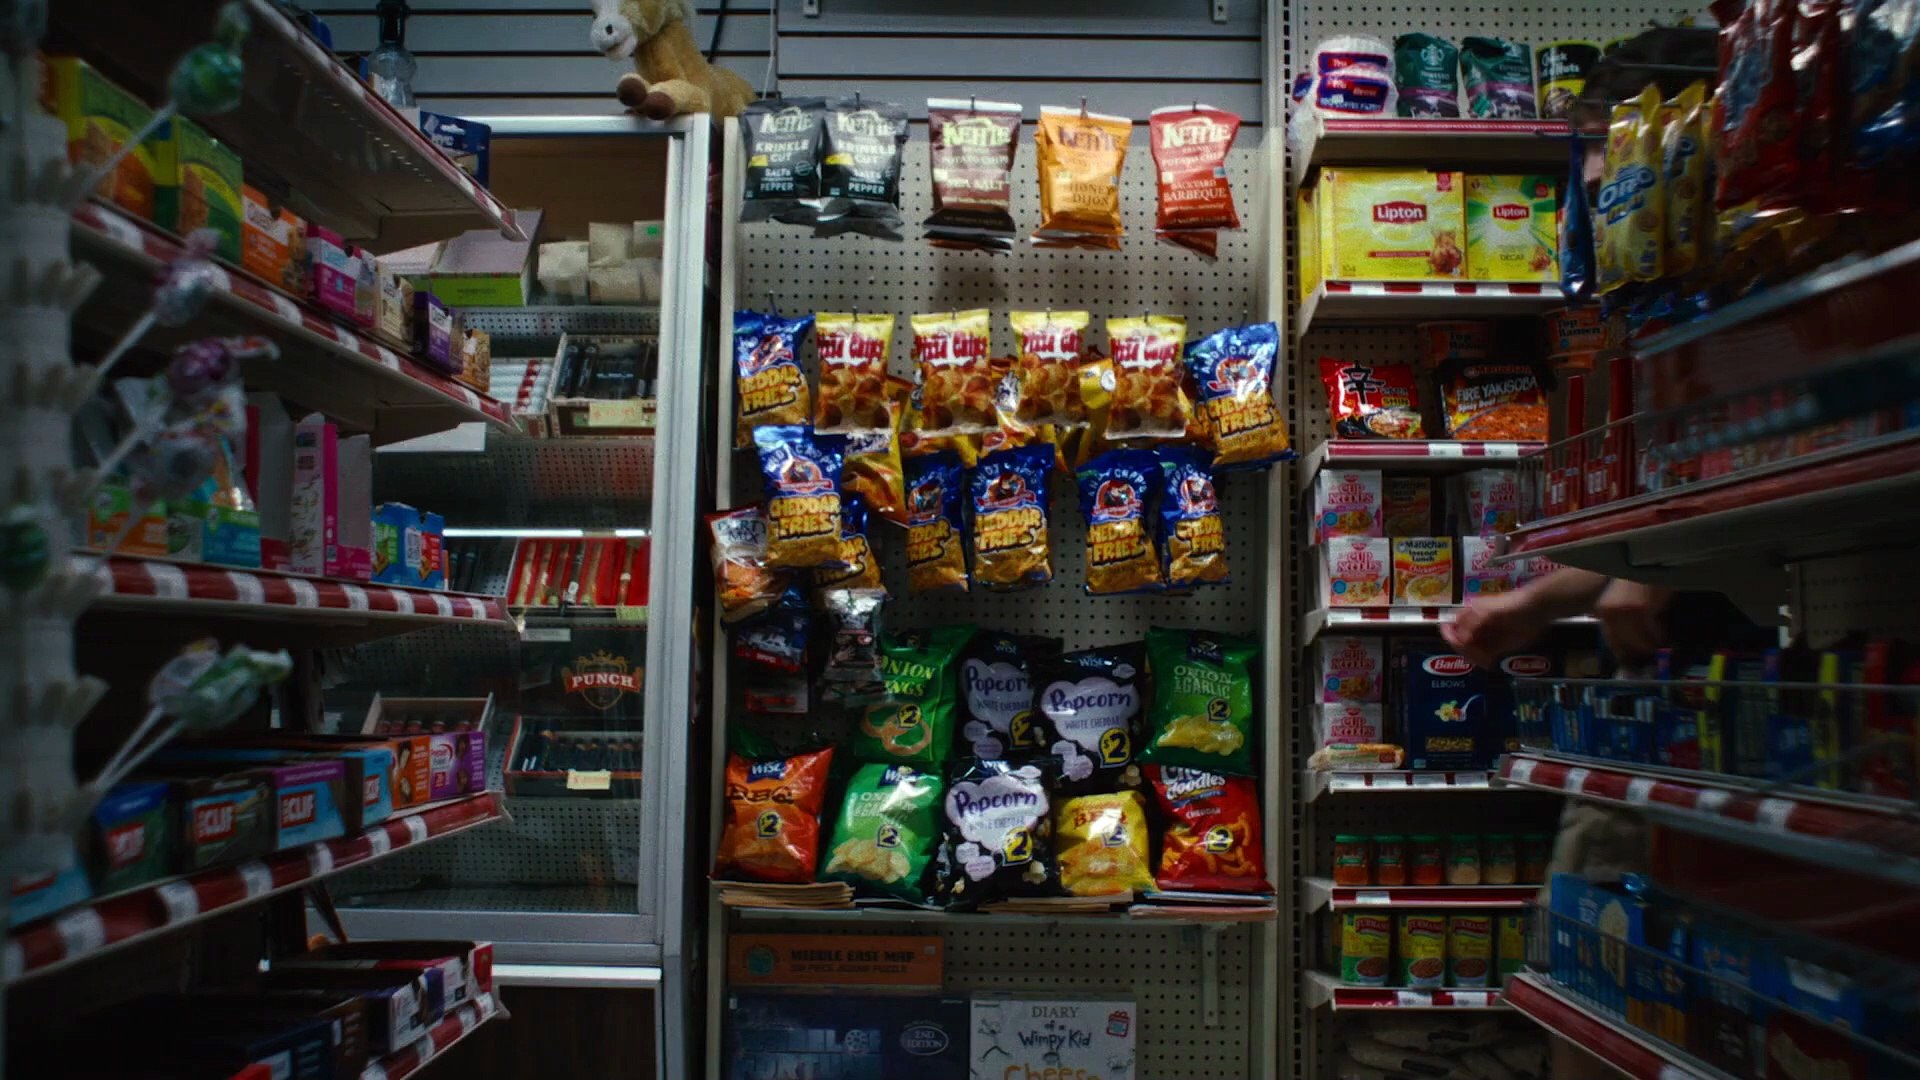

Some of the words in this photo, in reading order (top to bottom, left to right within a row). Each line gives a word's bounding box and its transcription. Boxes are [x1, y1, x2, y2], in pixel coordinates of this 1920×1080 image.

[756, 139, 809, 152] KRINKLE
[770, 152, 792, 163] CUT
[760, 182, 795, 193] PEPPER
[848, 183, 886, 195] PEPPER
[1164, 188, 1228, 202] BARBEQUE
[1377, 206, 1423, 221] Lipton
[1496, 206, 1527, 217] Lipton
[1456, 385, 1480, 402] FIRE
[1481, 376, 1538, 398] YAKISOBA
[769, 494, 840, 519] CHEDDAR
[779, 514, 834, 538] FRIES
[1093, 539, 1147, 563] FRIES
[1406, 540, 1449, 550] Maruchan
[1434, 657, 1471, 671] Barilla
[571, 674, 635, 689] PUNCH
[966, 665, 1029, 697] Popcor
[1173, 665, 1234, 685] ONION
[1183, 678, 1231, 700] GARLIC
[1431, 680, 1466, 689] ELBOWS
[1050, 686, 1132, 713] Popcorn
[1103, 732, 1126, 760] $2
[1166, 772, 1226, 800] doodles
[954, 790, 1038, 818] Popcorn
[847, 951, 879, 962] EAST
[884, 951, 915, 963] MAP
[1031, 1006, 1080, 1019] DIARY
[905, 1038, 943, 1050] EDITION
[1017, 1030, 1065, 1051] Wimpy
[1068, 1030, 1092, 1049] Kid
[1003, 1062, 1098, 1080] Chees
